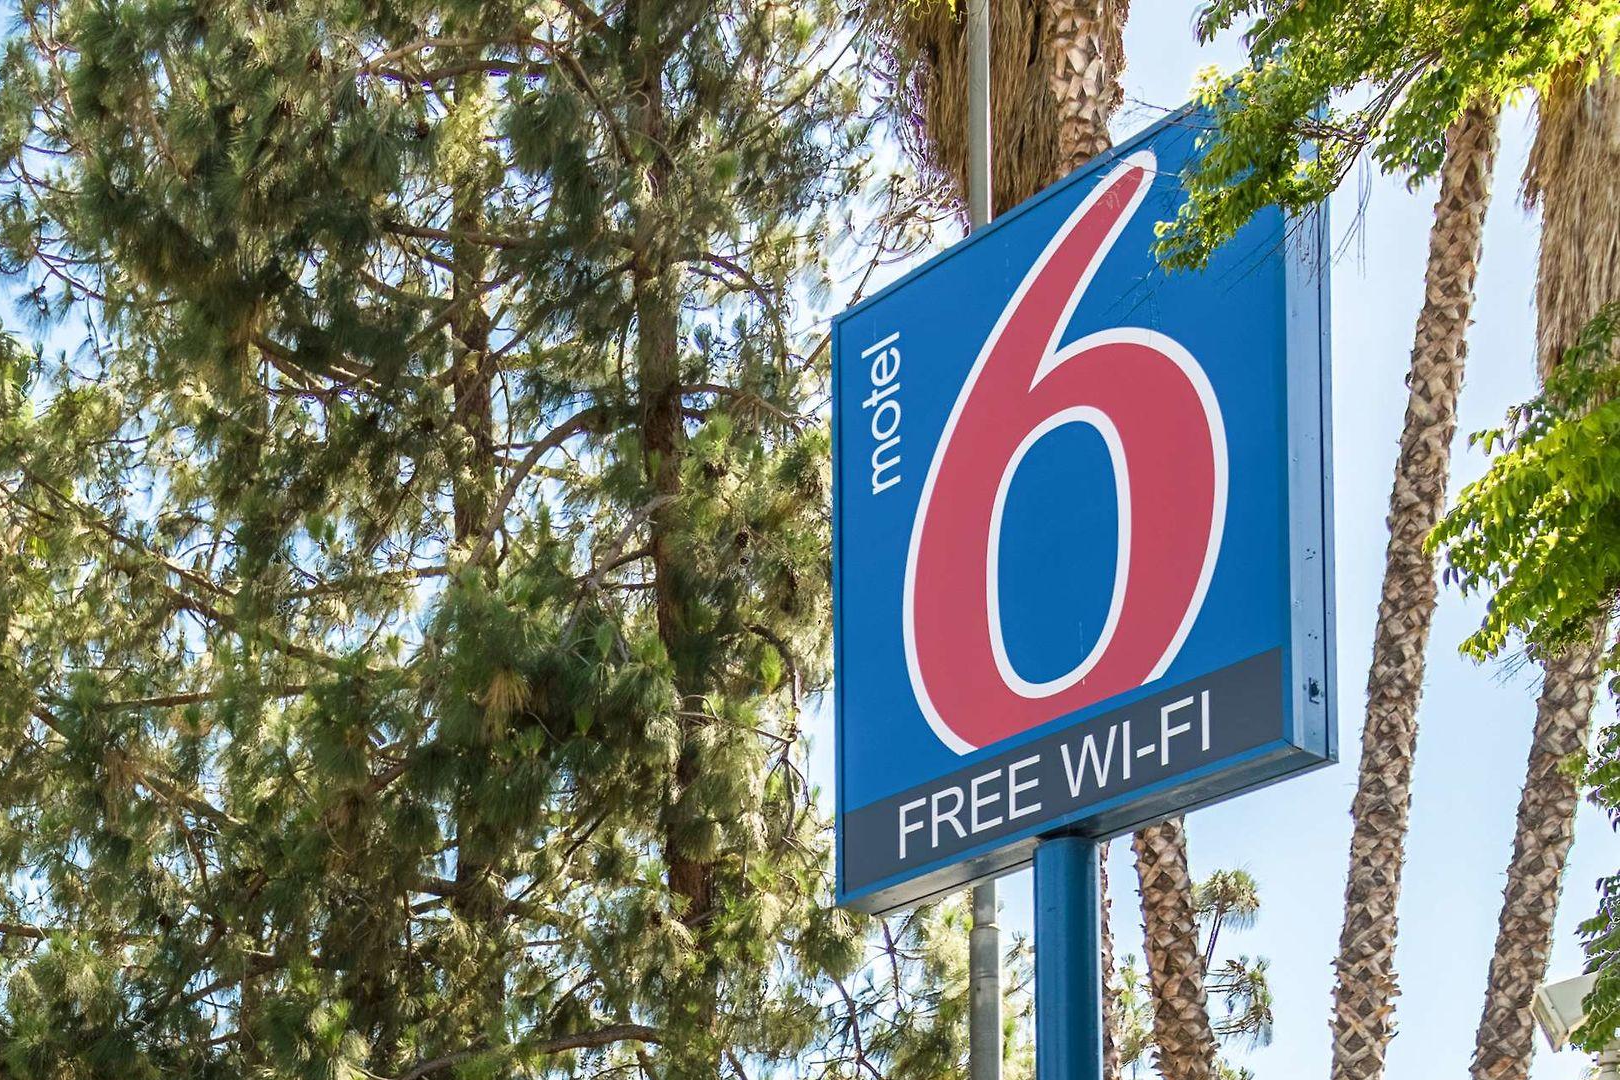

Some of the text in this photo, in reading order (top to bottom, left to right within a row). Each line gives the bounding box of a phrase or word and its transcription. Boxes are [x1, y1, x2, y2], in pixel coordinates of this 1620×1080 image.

[861, 331, 902, 496] motel
[902, 150, 1229, 757] 6
[898, 689, 1210, 860] FREE WI-FI
